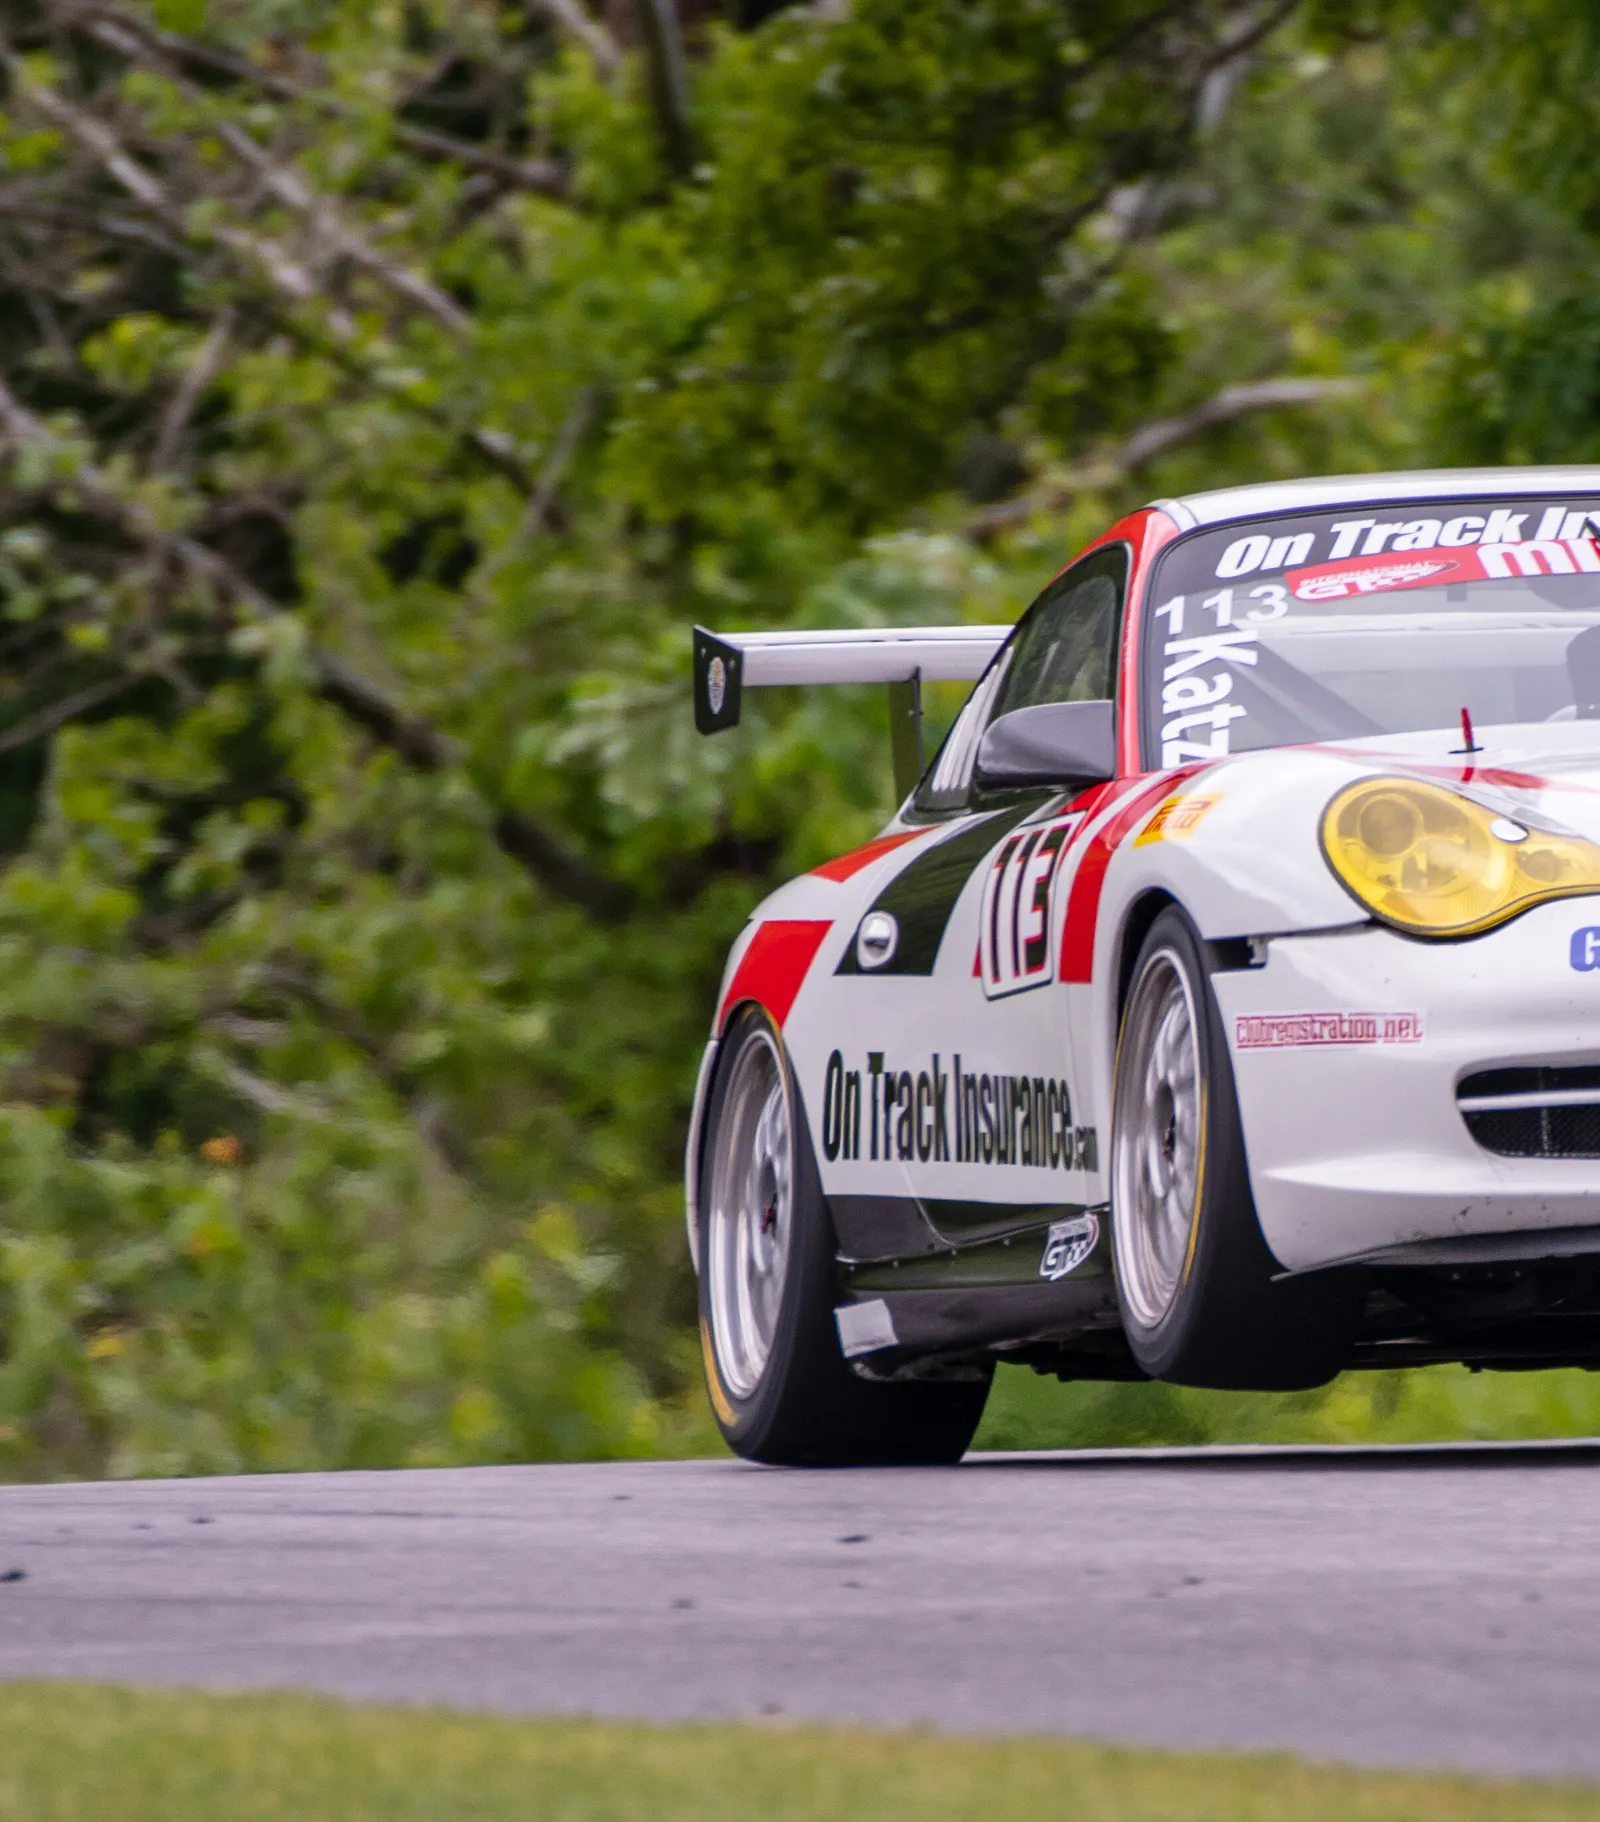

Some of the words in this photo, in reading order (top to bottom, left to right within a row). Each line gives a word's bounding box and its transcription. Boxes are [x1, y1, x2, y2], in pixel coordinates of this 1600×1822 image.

[1215, 533, 1316, 578] On
[1328, 508, 1530, 560] Track
[1155, 583, 1289, 635] 113
[1161, 628, 1259, 768] Katz
[994, 823, 1072, 984] 113
[1236, 1013, 1423, 1048] clubregistration.net
[823, 1048, 861, 1162] On
[867, 1051, 950, 1163] Track
